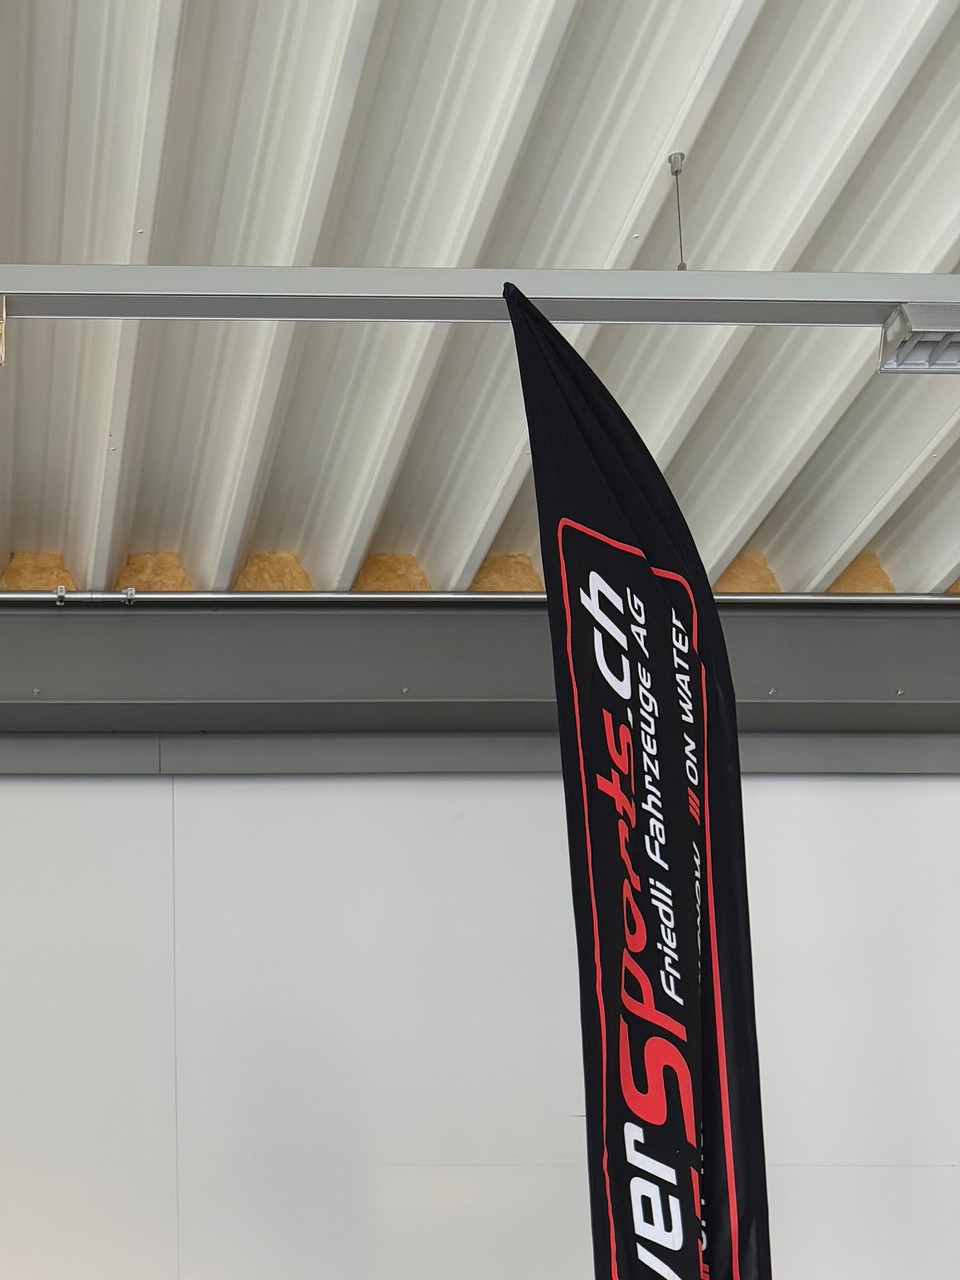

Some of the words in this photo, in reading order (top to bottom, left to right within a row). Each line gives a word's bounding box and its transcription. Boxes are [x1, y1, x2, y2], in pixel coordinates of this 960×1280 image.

[626, 586, 650, 659] AG
[637, 662, 670, 871] Fahrzeuge
[682, 732, 700, 786] ON
[648, 877, 685, 1006] Friedli
